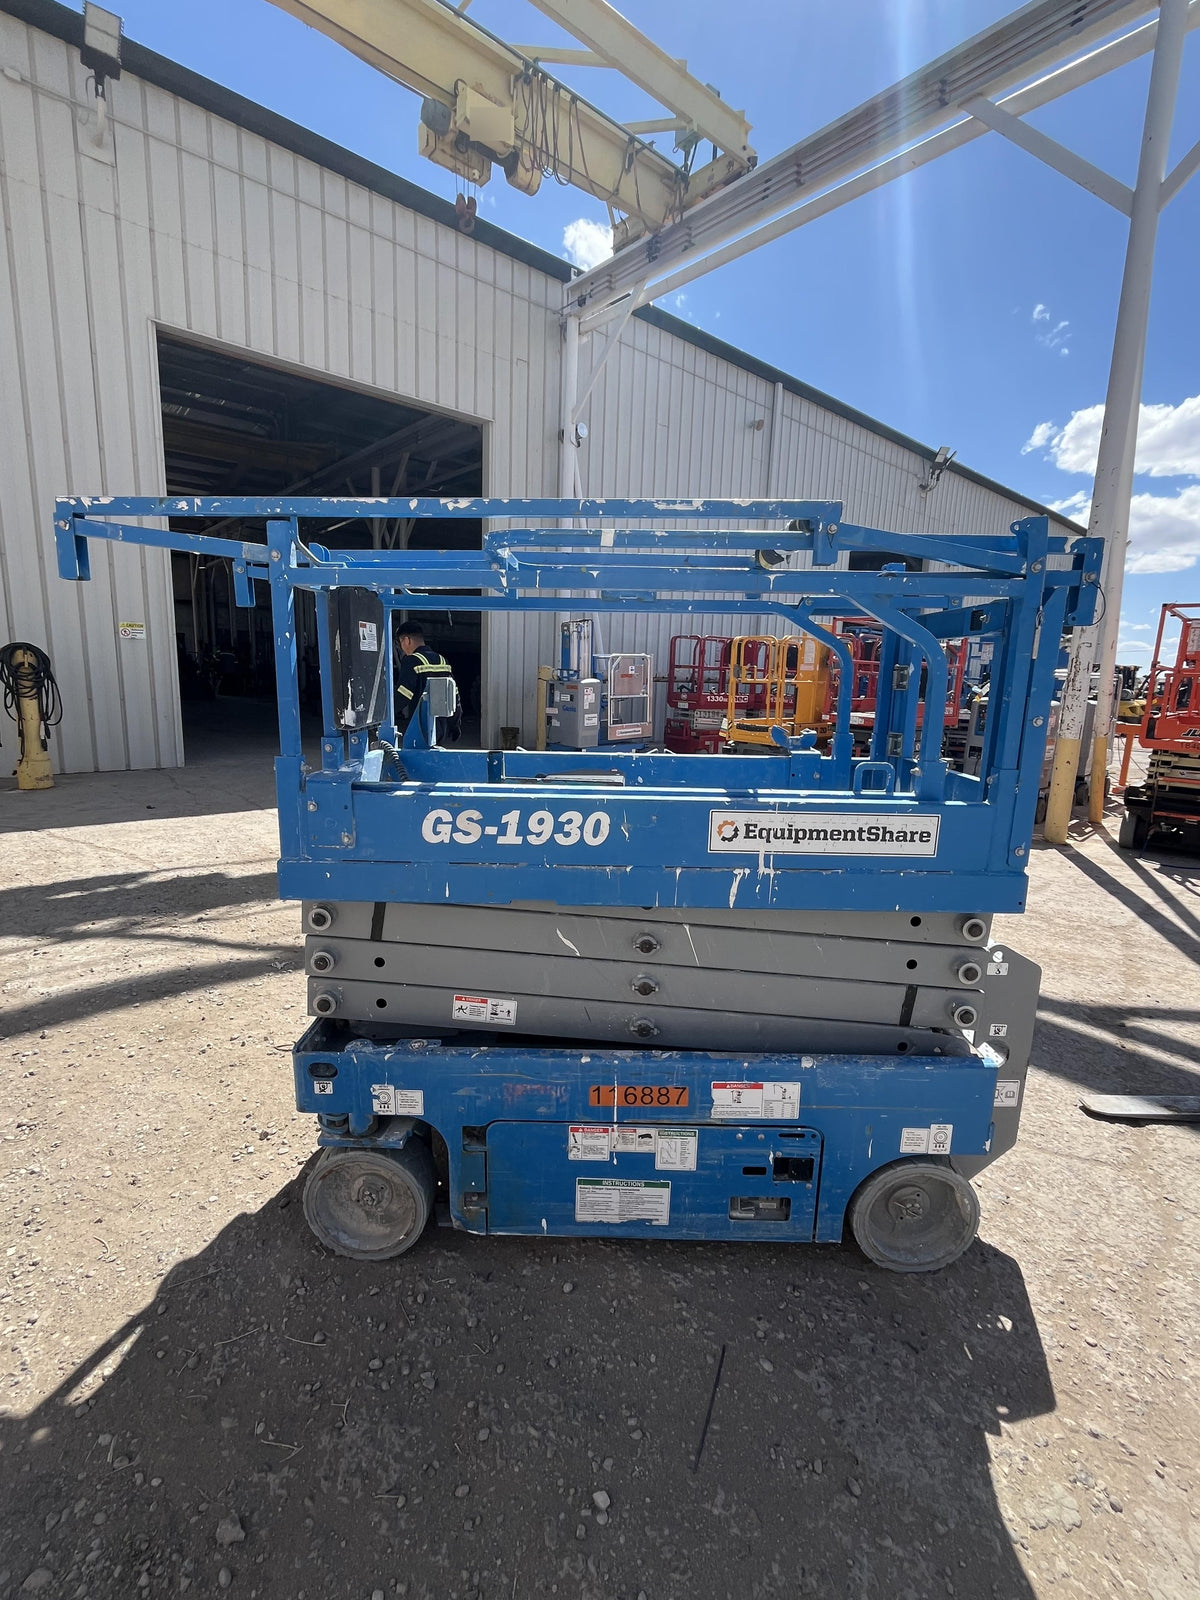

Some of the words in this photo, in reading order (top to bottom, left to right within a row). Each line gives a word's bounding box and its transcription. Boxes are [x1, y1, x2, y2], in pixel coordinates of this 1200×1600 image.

[421, 808, 611, 846] GS-1930
[743, 823, 932, 844] EquipmentShare
[592, 1086, 688, 1105] 116887
